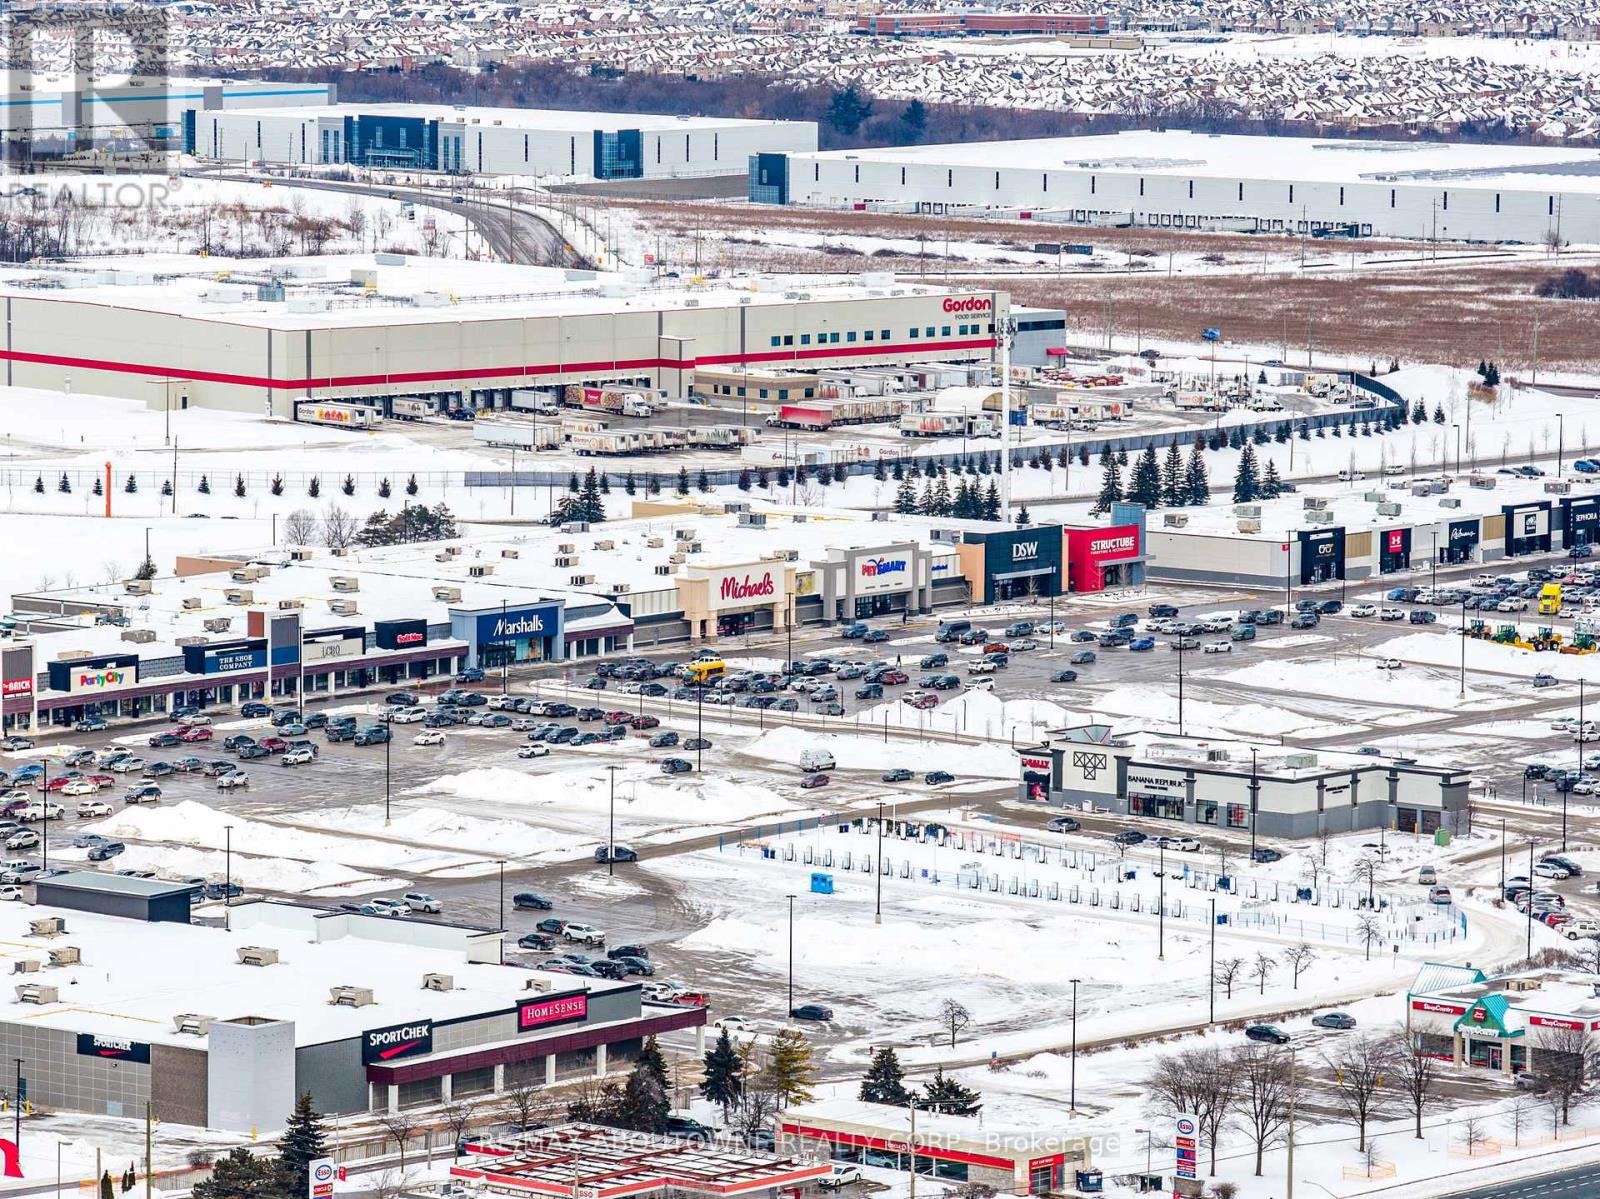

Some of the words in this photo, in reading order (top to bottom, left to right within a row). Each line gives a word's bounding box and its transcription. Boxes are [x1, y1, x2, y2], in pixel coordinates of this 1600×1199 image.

[942, 296, 992, 313] Gordon
[1576, 512, 1597, 522] SEPHORA
[1012, 541, 1038, 558] DSW
[1091, 537, 1135, 551] STRUCTUBE
[720, 572, 774, 600] Michaels
[493, 614, 543, 637] Marshalls
[235, 654, 253, 663] SHOE
[219, 661, 253, 671] COMPANY
[8, 680, 31, 691] BRICK
[1128, 775, 1154, 785] BANANA
[1155, 778, 1185, 788] REPUBLIC
